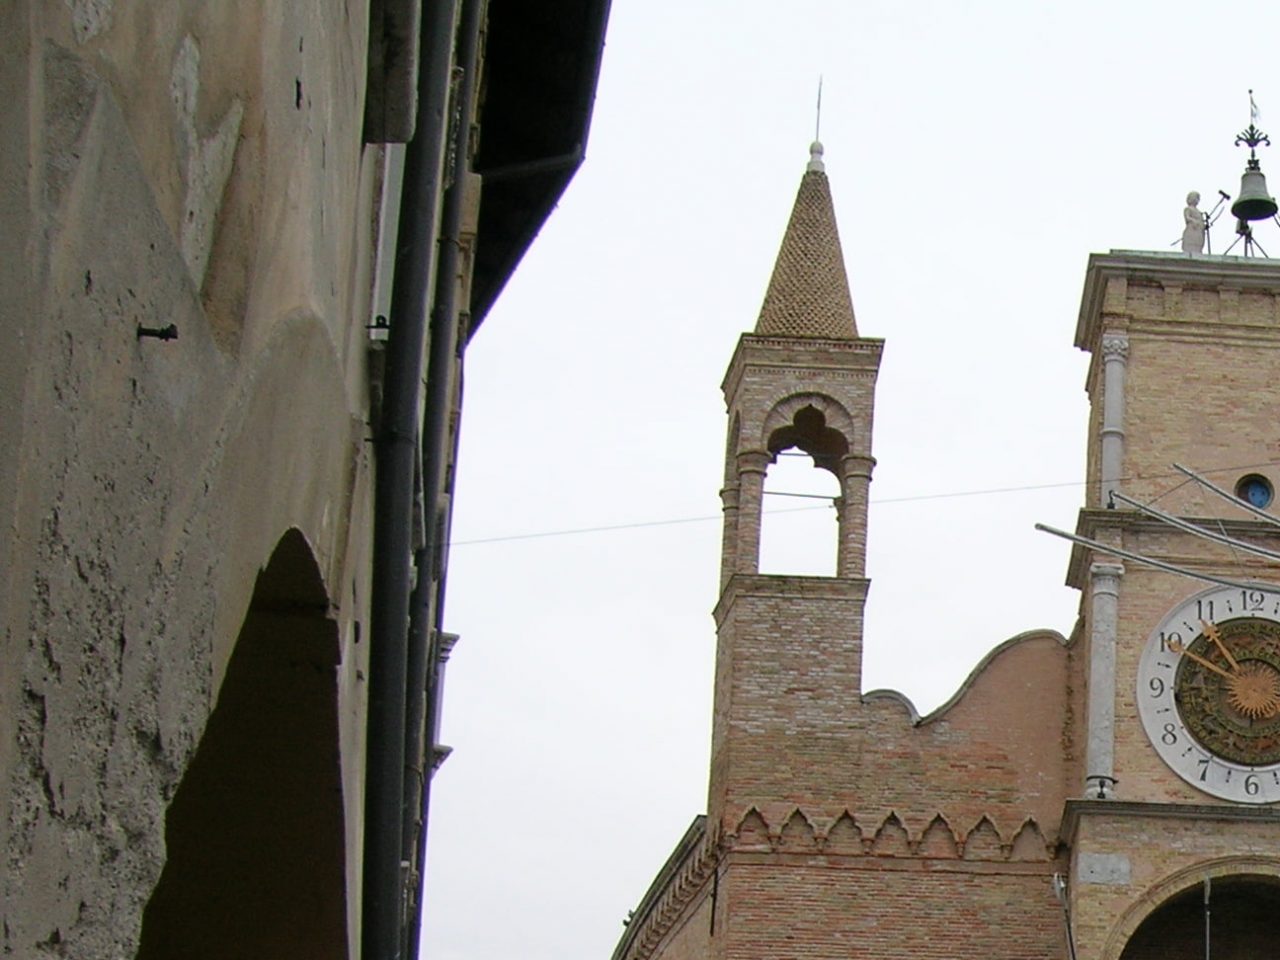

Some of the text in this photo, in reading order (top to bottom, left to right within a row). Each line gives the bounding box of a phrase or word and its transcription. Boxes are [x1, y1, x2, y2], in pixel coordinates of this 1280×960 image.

[1197, 600, 1215, 620] 11
[1241, 590, 1265, 612] 12
[1160, 632, 1183, 654] 10
[1149, 677, 1165, 698] 9
[1161, 723, 1178, 746] 8
[1198, 759, 1211, 782] 7
[1244, 774, 1260, 796] 6
